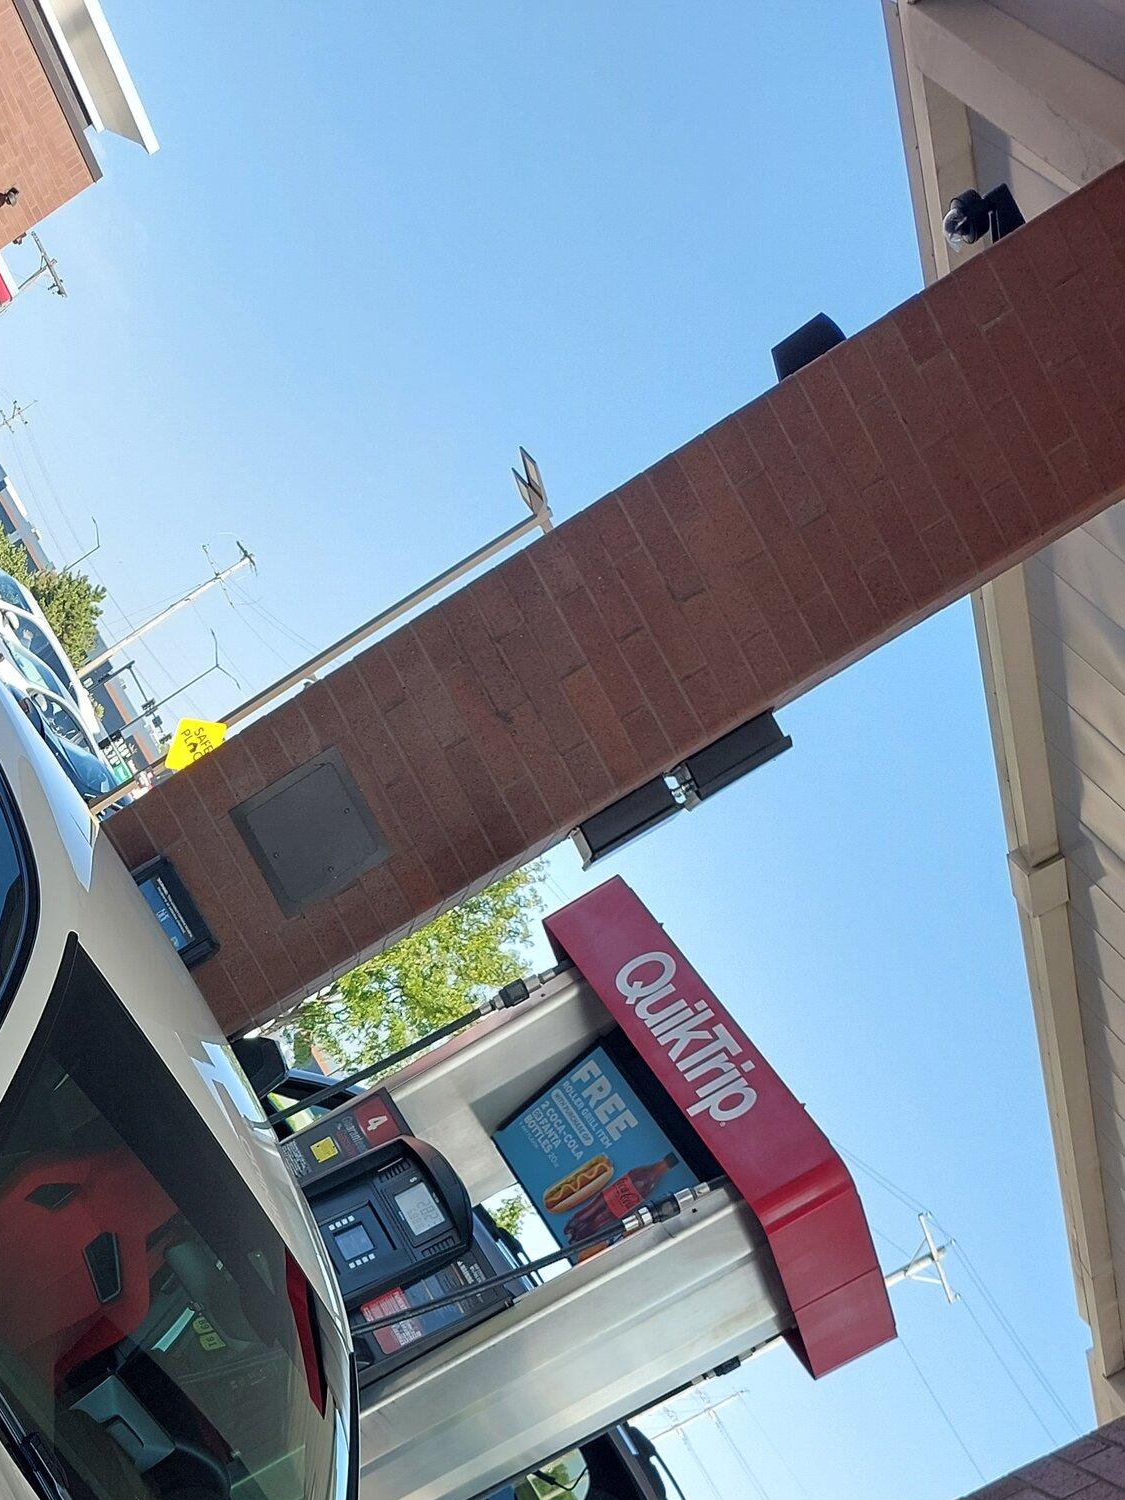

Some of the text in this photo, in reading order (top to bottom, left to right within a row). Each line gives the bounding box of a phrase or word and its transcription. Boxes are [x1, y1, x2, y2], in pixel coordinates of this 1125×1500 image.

[180, 728, 202, 761] PLAC
[193, 726, 214, 754] SAFE
[615, 951, 757, 1122] QuikTrip
[561, 1080, 612, 1148] ROLLER GRILL ITEM
[570, 1058, 638, 1141] FREE
[367, 1116, 388, 1132] 4
[523, 1114, 553, 1154] BOTTLES
[538, 1118, 561, 1148] FANTA
[540, 1100, 583, 1160] 2 COCA-COLA
[562, 1104, 584, 1134] PURCHASE
